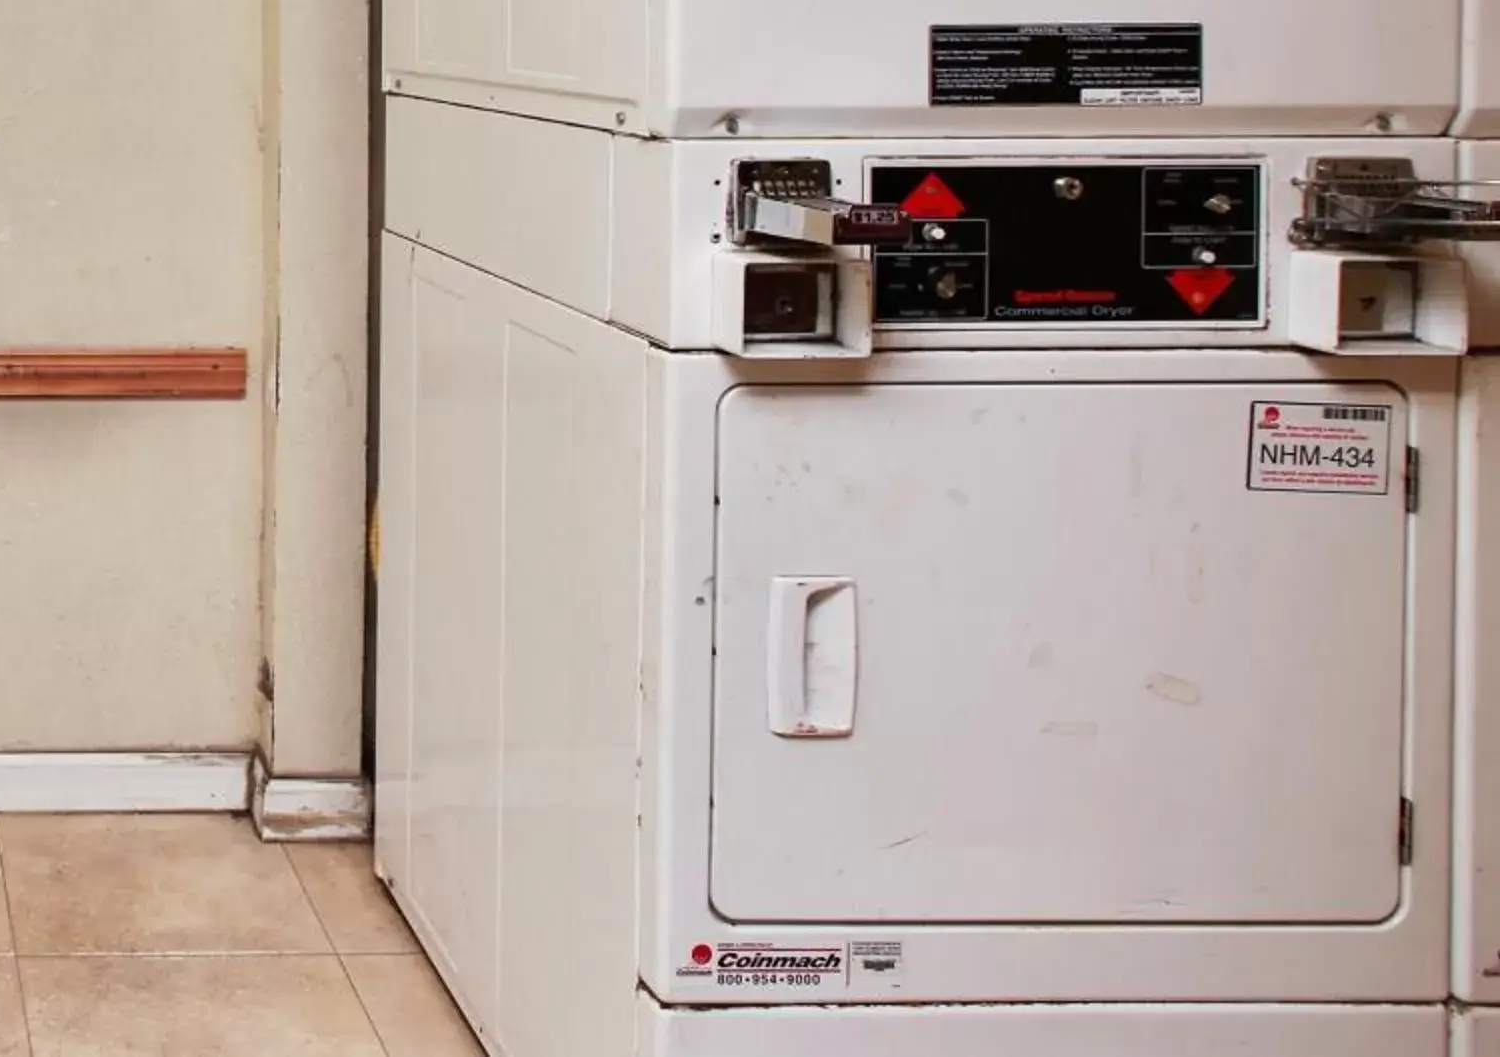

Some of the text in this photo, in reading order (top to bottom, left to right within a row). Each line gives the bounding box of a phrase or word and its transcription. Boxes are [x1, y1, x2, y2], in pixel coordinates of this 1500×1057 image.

[994, 305, 1135, 317] Commercial Dryer
[1260, 444, 1375, 468] NHM-434
[718, 953, 841, 969] Coinmach
